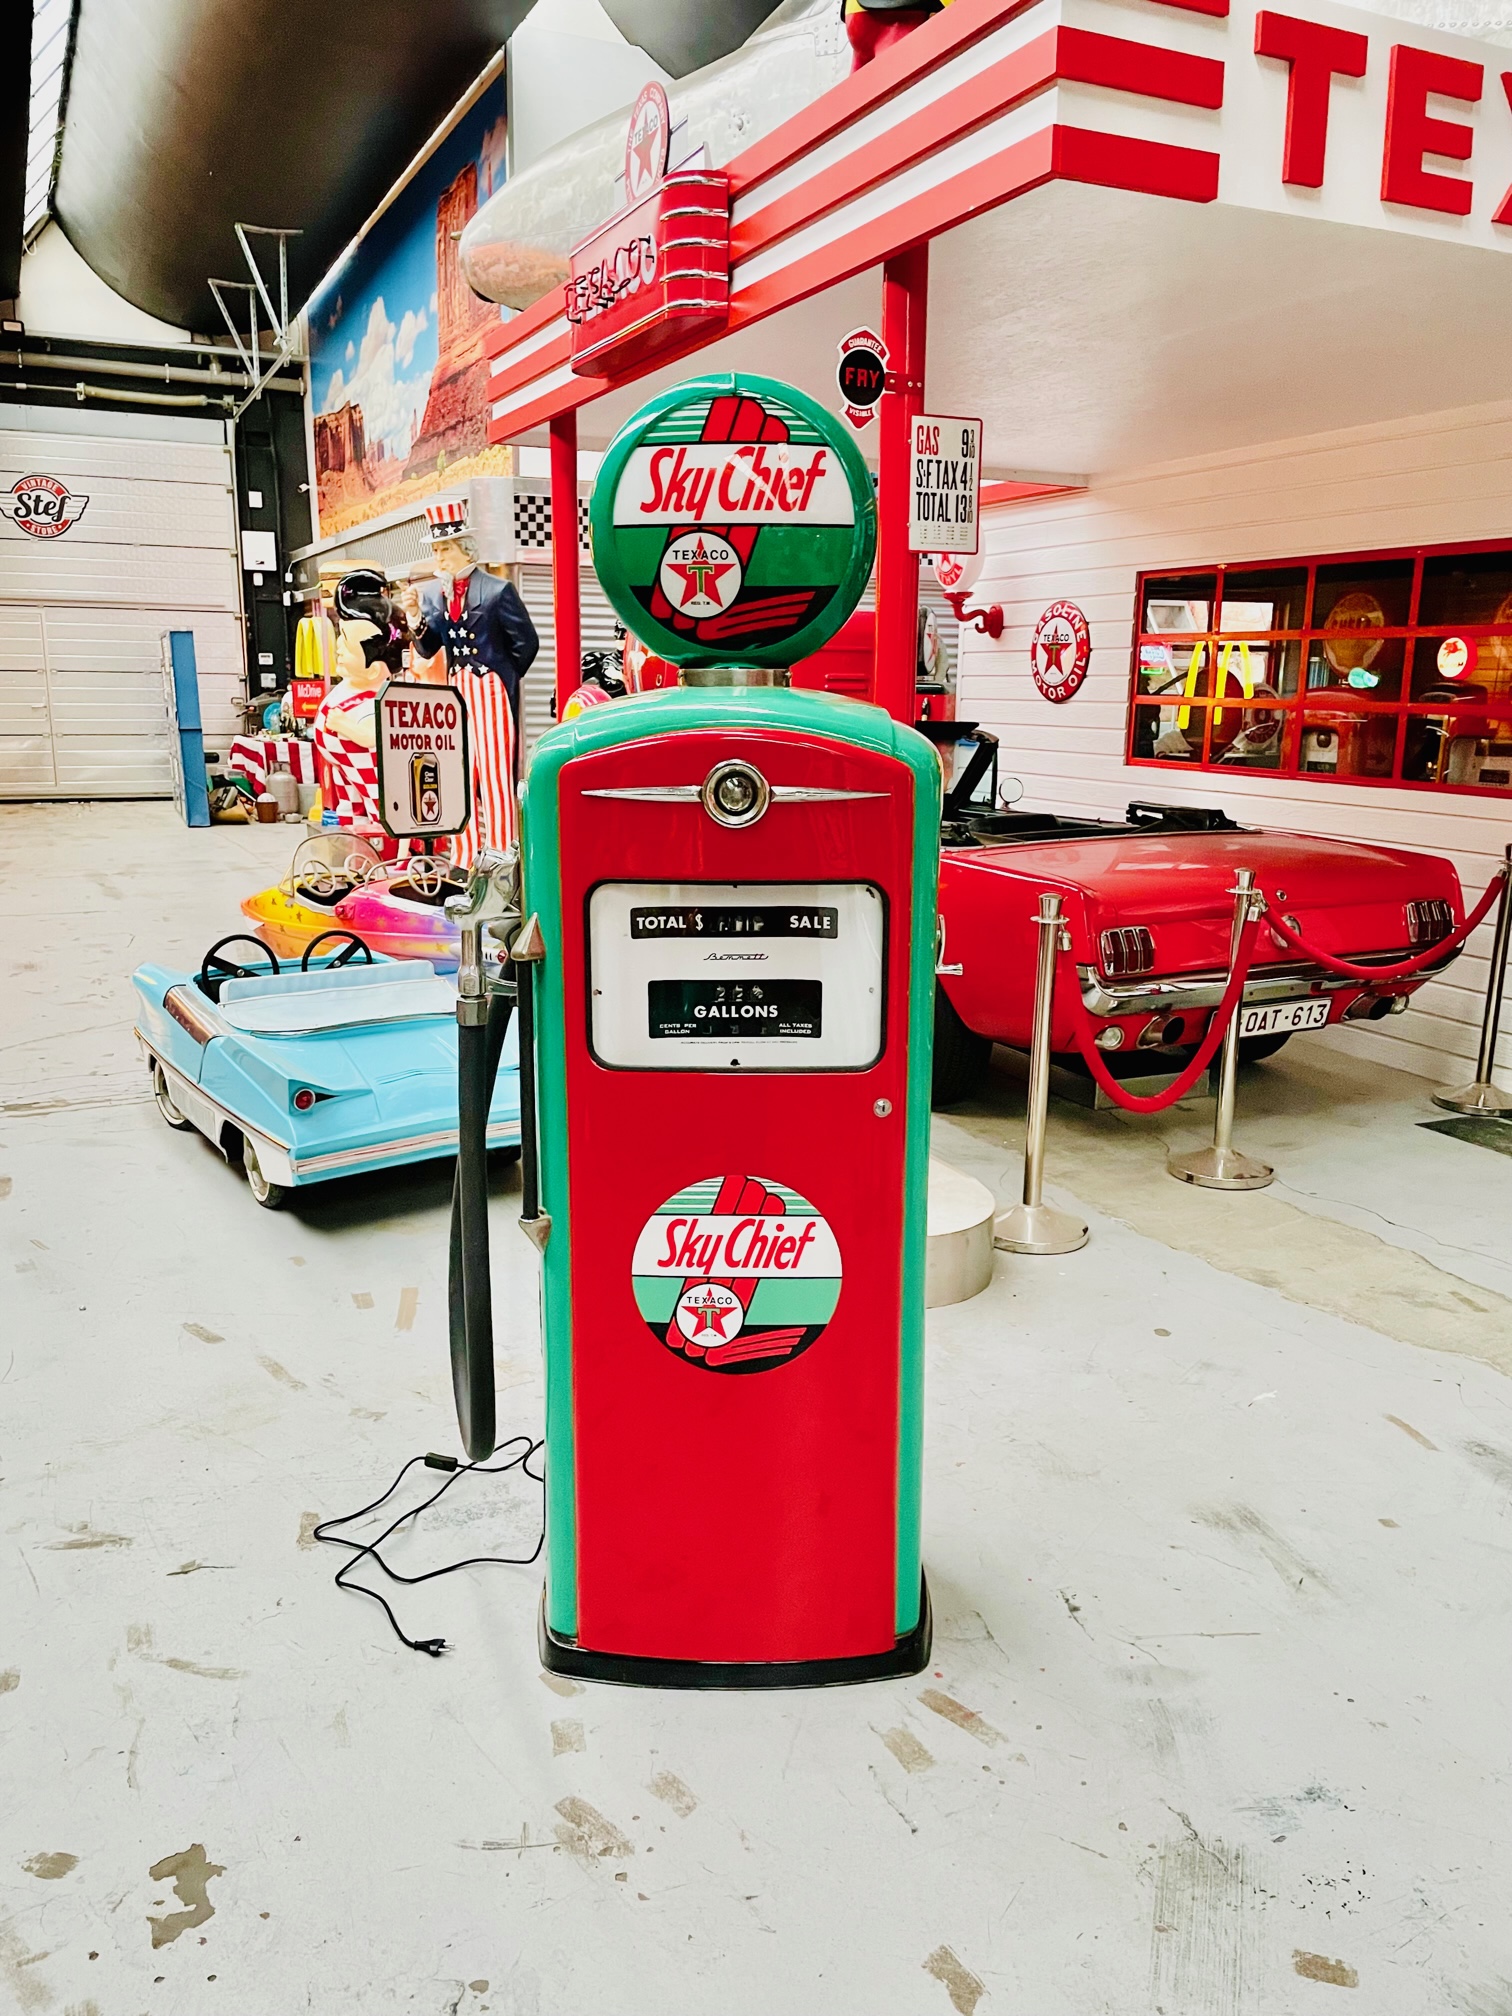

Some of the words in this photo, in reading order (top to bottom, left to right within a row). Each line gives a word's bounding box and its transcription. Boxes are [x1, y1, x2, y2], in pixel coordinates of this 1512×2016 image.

[1254, 10, 1512, 225] TE
[848, 336, 882, 353] GUARANTEE
[849, 406, 872, 417] VISIBLE
[916, 424, 941, 456] GAS
[21, 478, 59, 491] VINTAGE
[639, 447, 718, 521] Sky
[718, 446, 827, 512] Chief
[935, 460, 958, 491] TAX
[14, 492, 72, 522] Stef
[916, 491, 951, 522] TOTAL
[30, 525, 59, 535] STORE
[672, 549, 729, 561] TEXACO
[937, 567, 963, 585] THYL
[1032, 603, 1087, 644] GASOLINE
[1043, 633, 1070, 642] TEXACO
[1031, 659, 1067, 700] MOTOR
[1068, 657, 1086, 687] OIL
[297, 684, 322, 698] McDrive
[384, 700, 457, 730] TEXACO
[389, 733, 433, 751] MOTOR
[435, 734, 456, 751] OIL
[636, 915, 687, 930] TOTAL
[789, 915, 831, 929] SALE
[693, 1005, 779, 1018] GALLONS
[657, 1218, 724, 1275] Sky
[723, 1218, 817, 1270] Chief
[686, 1296, 733, 1305] TEXACO
